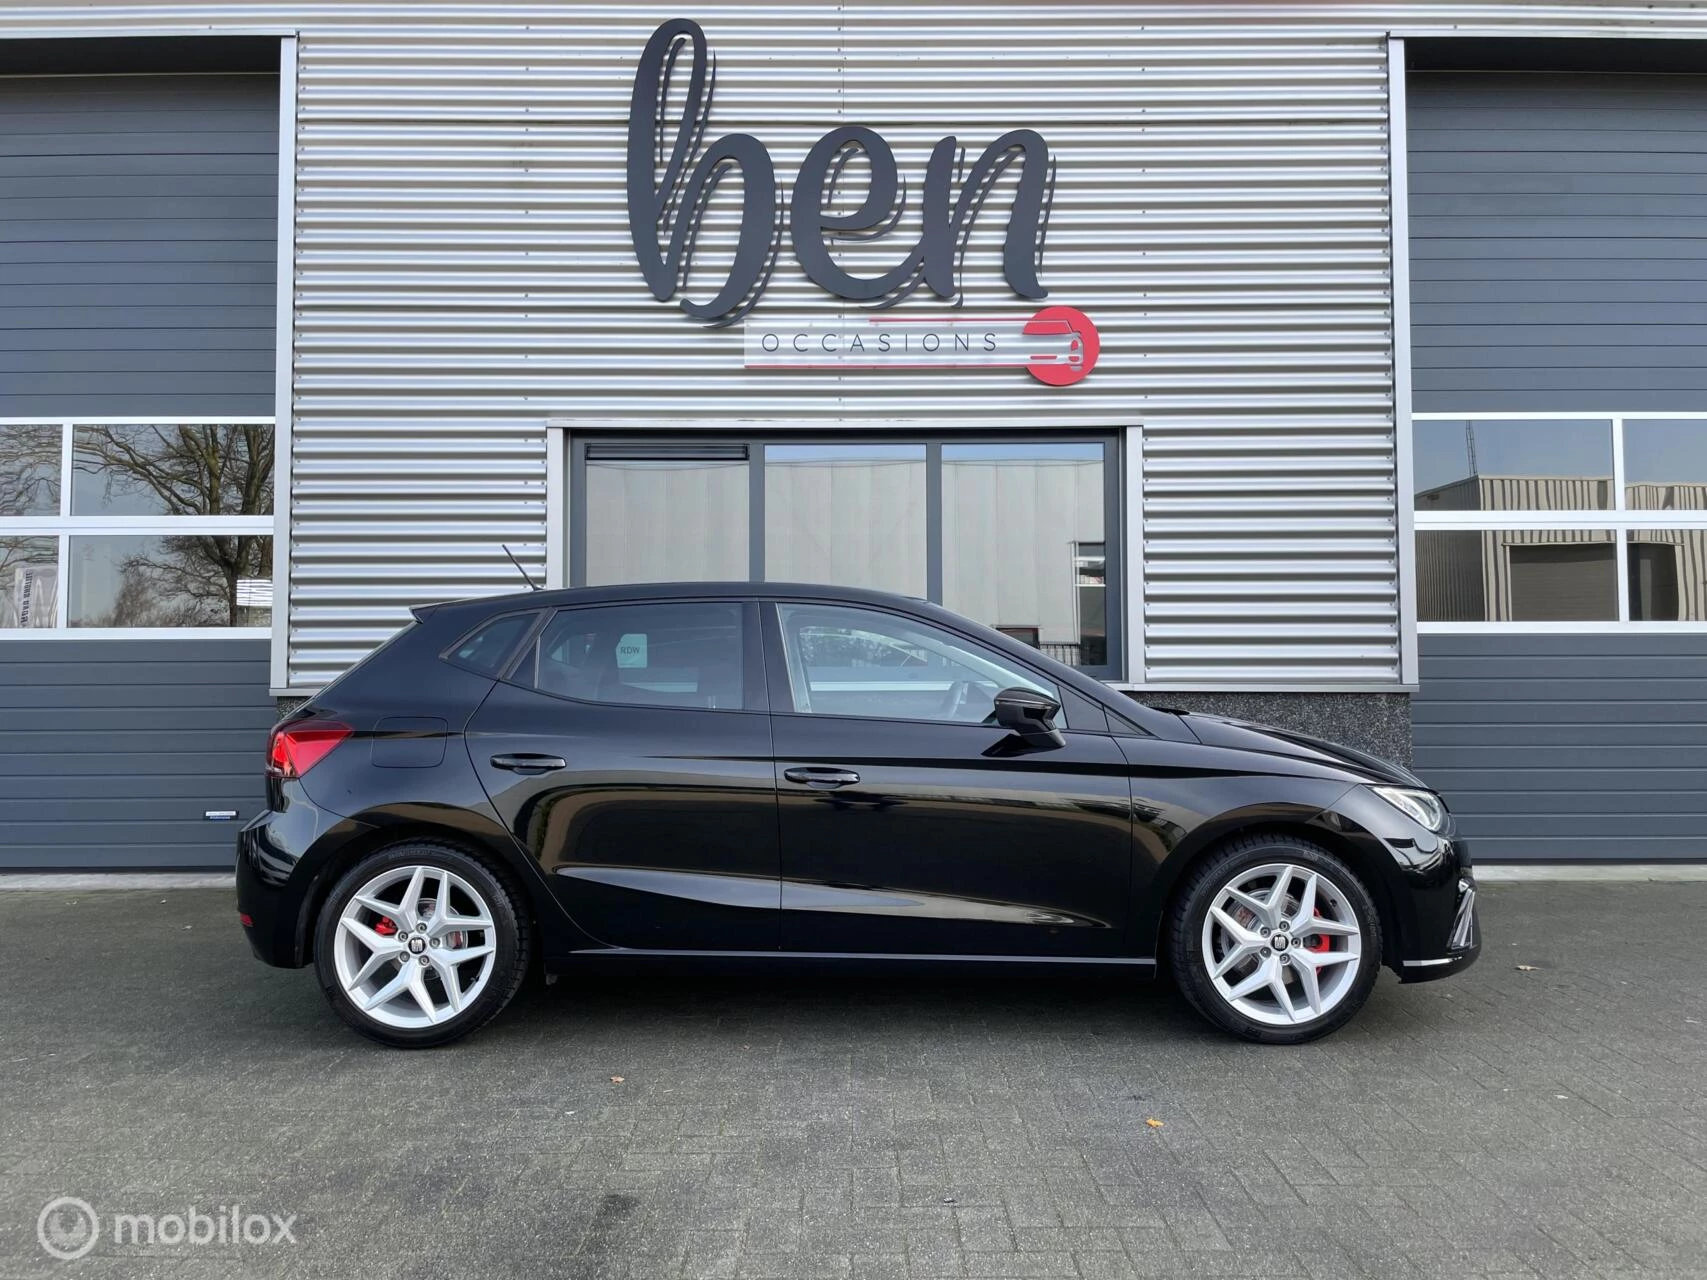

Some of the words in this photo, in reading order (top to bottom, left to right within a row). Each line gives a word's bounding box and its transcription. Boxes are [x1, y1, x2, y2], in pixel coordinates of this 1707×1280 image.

[627, 18, 1056, 328] ben
[761, 332, 998, 353] OCCASIONS
[620, 646, 640, 655] RDW
